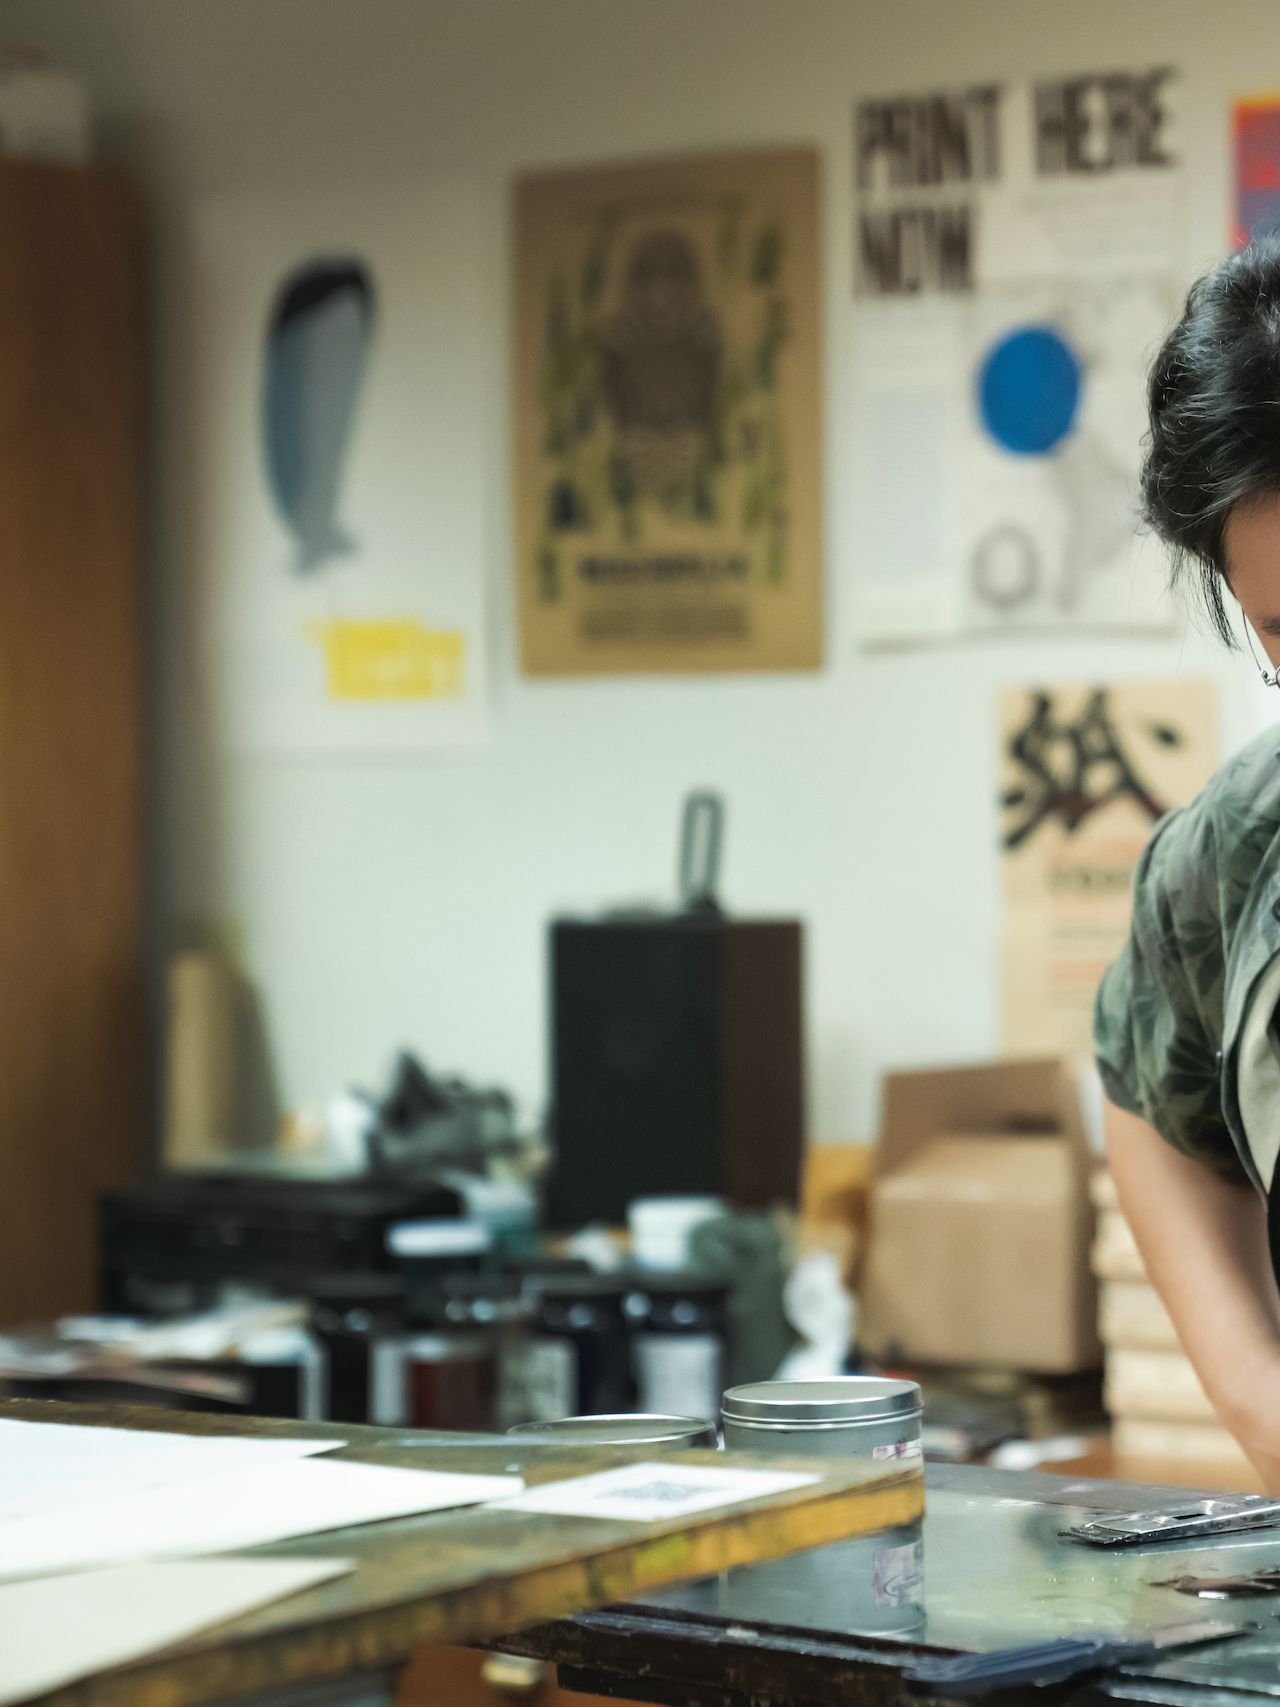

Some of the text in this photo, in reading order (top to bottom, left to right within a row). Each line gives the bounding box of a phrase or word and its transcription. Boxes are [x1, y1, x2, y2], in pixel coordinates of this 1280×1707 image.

[856, 66, 1178, 190] PRINT HERE
[856, 206, 975, 299] NOW
